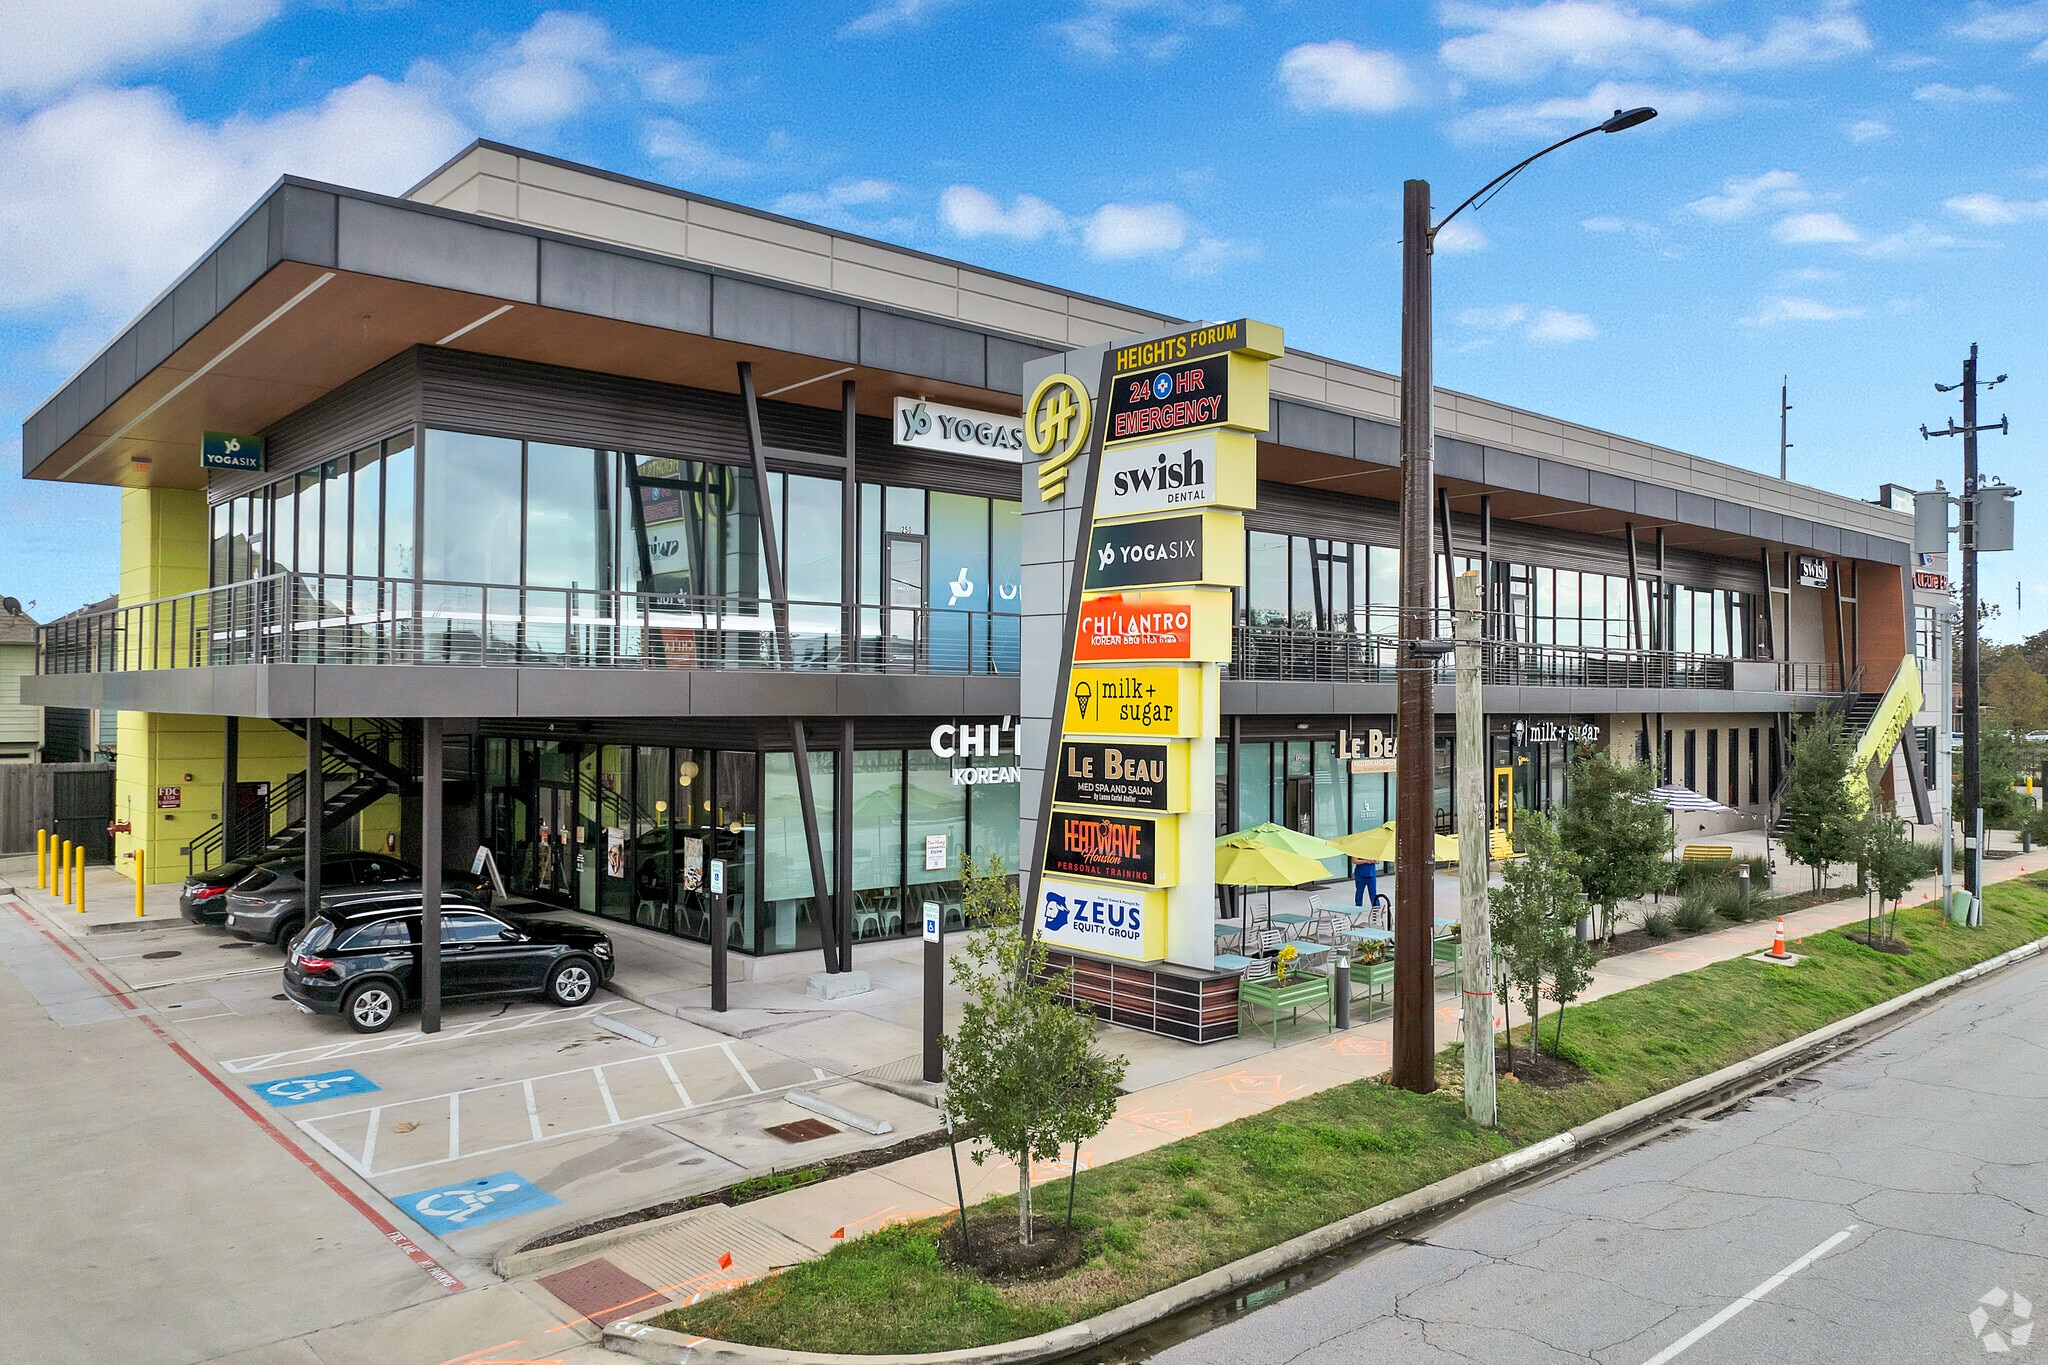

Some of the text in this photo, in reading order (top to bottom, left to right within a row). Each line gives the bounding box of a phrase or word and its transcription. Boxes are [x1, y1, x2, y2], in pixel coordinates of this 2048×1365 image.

[1117, 324, 1237, 372] HEIGHTS FORUM
[1129, 369, 1204, 404] 24 HR
[1115, 395, 1222, 437] EMERGENCY
[207, 454, 257, 467] YOGASIX
[1114, 449, 1206, 496] swish
[1167, 490, 1206, 503] DENTAL
[1120, 540, 1196, 564] YOGASIX
[1803, 559, 1828, 580] swish
[1082, 611, 1188, 636] CHI'LANTRO
[1091, 634, 1122, 646] KOREAN
[1120, 702, 1173, 726] sugar
[1339, 730, 1361, 758] LE
[952, 766, 1021, 786] KOREAN
[1068, 747, 1164, 783] LE BEAU
[1077, 782, 1153, 796] MED SPA AND SALON
[1064, 819, 1142, 860] HEATWAVE
[1081, 846, 1122, 865] Houston
[1057, 861, 1148, 880] PERSONAL TRAINING
[1074, 899, 1140, 930] ZEUS
[1074, 922, 1140, 940] EQUITY GROUP
